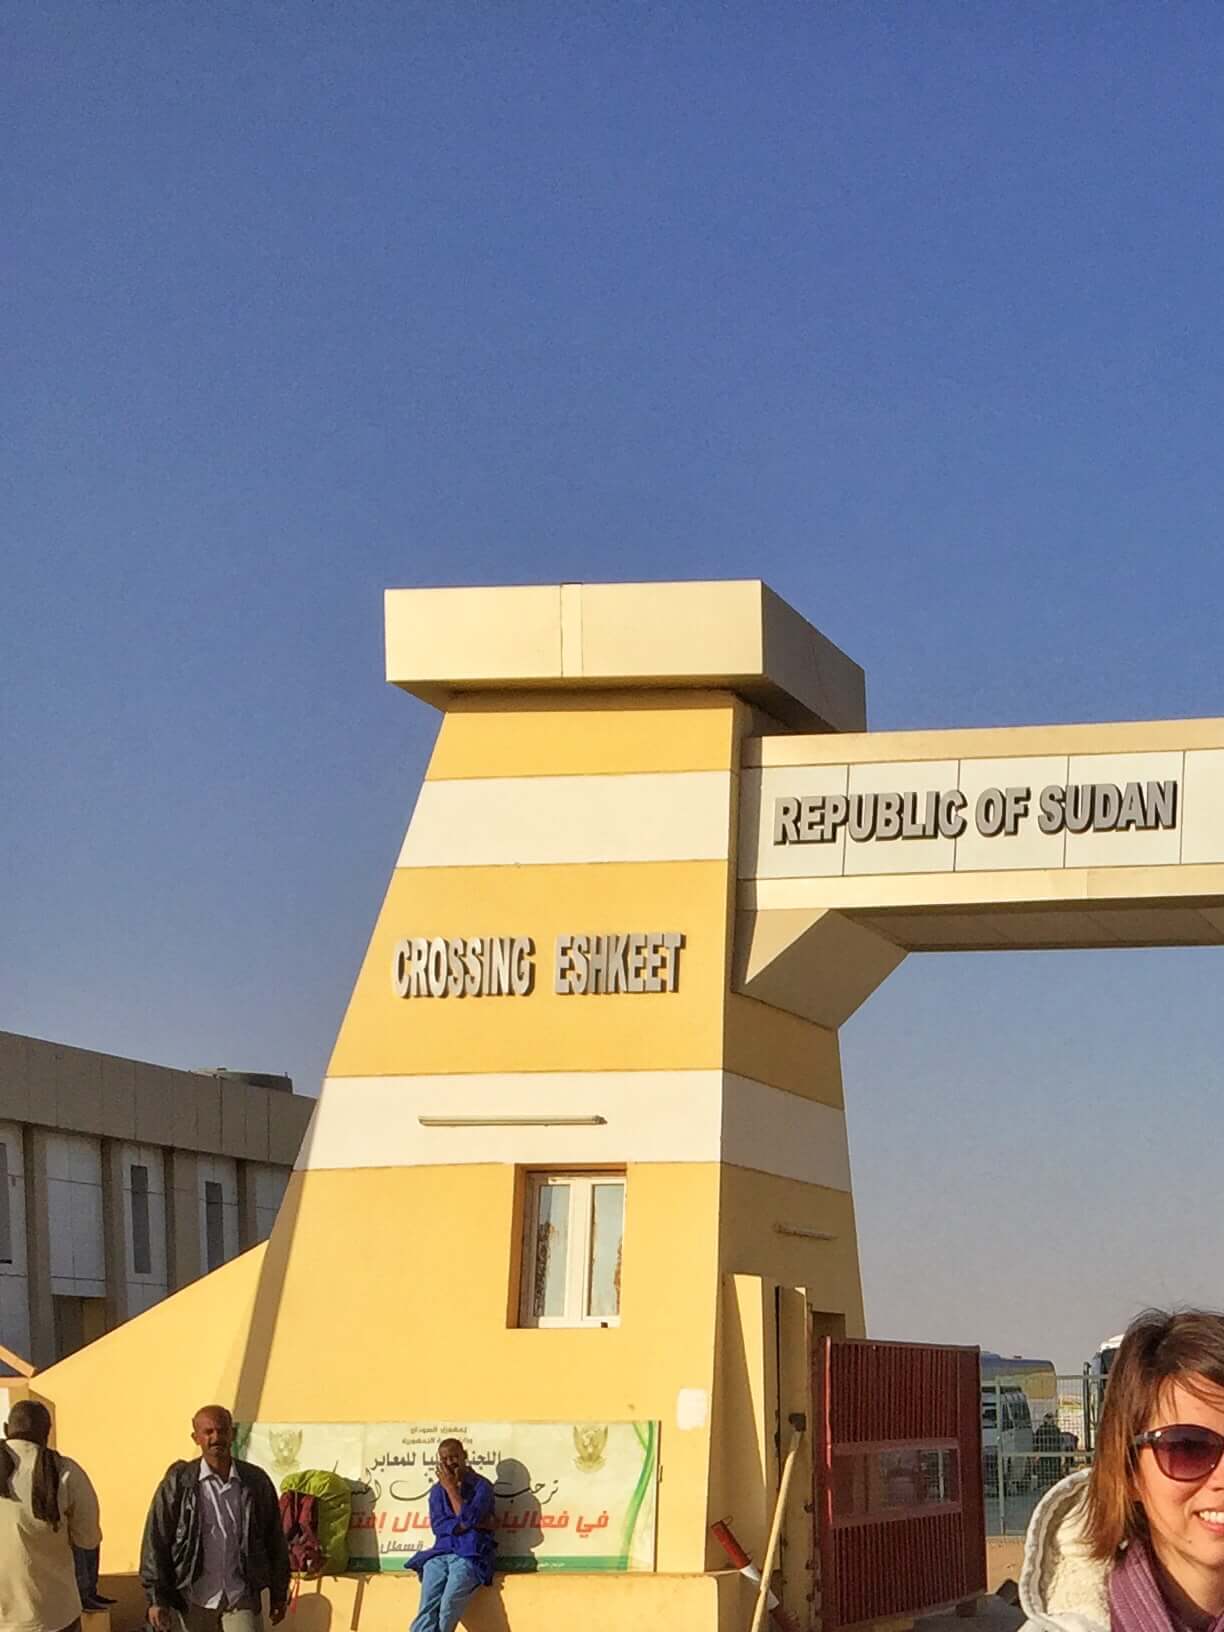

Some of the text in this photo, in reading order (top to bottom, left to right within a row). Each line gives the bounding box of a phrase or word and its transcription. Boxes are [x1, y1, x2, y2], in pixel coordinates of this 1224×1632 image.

[773, 780, 1178, 846] REPUBLIC OF SUDAN
[393, 934, 687, 998] CROSSING ESHKEET
[576, 1510, 609, 1538] في
